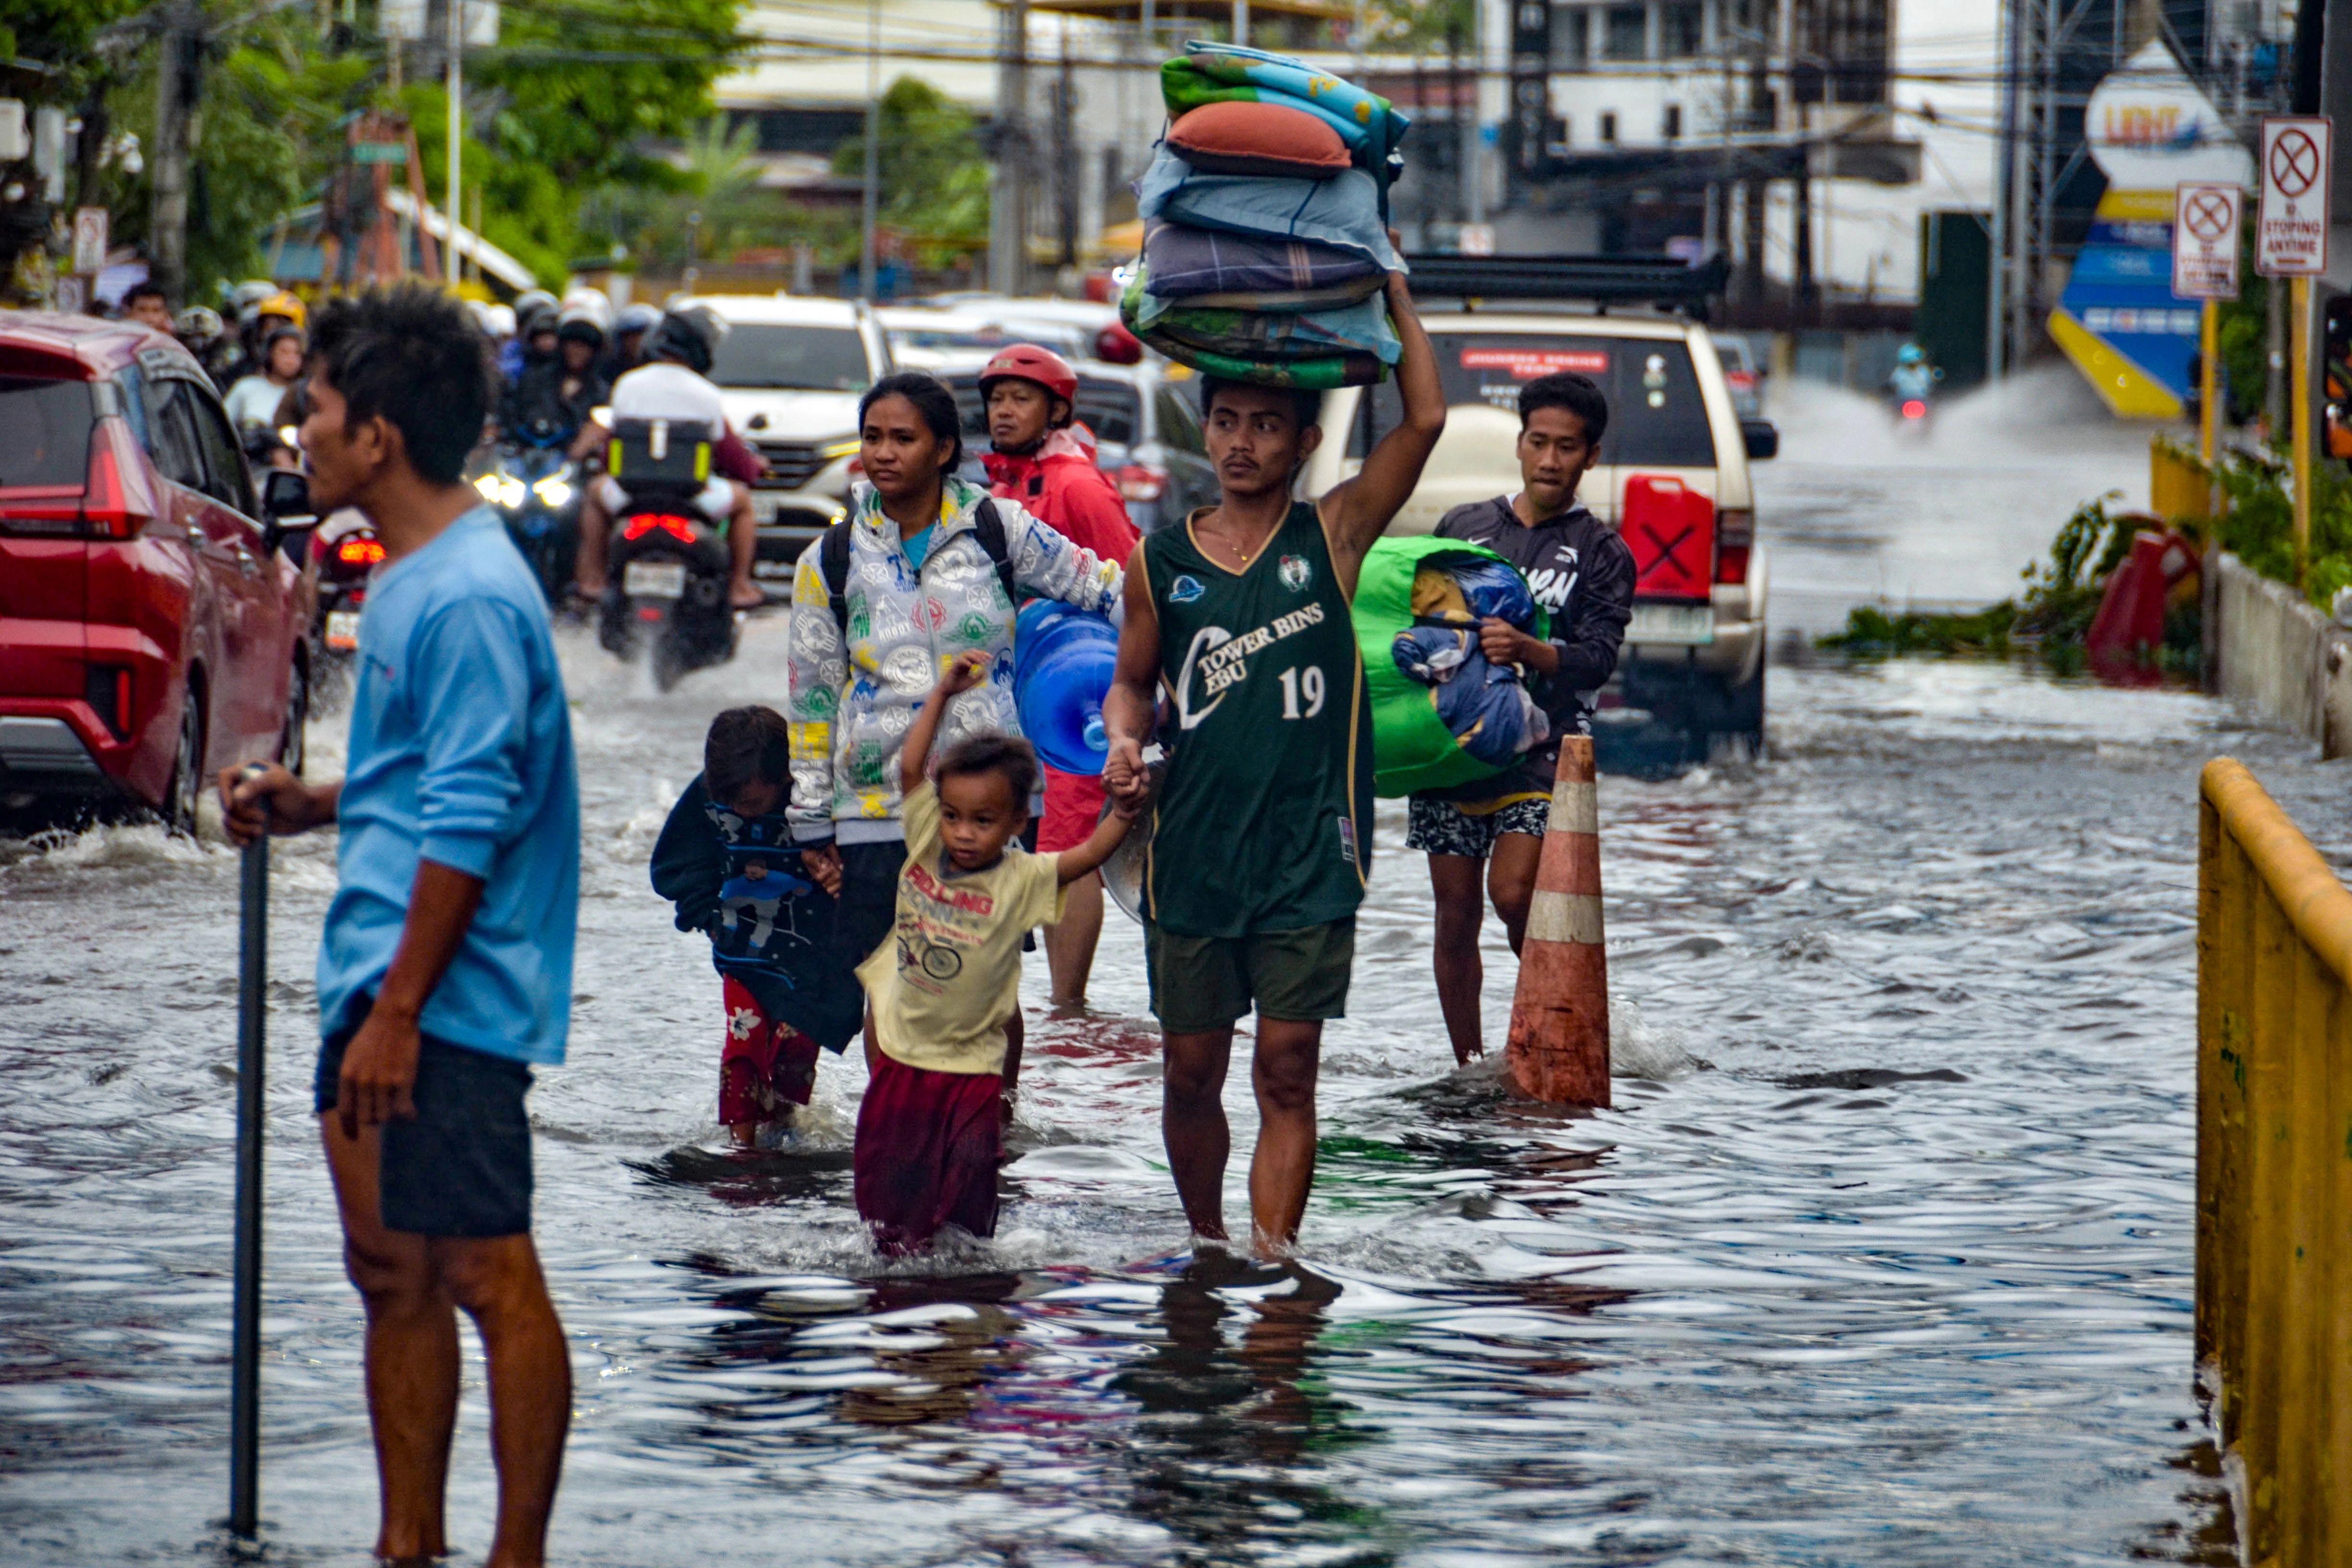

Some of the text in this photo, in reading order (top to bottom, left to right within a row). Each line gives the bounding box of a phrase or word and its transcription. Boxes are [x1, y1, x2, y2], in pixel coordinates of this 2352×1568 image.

[1198, 602, 1324, 678] TOWER BINS
[1278, 665, 1325, 719] 19
